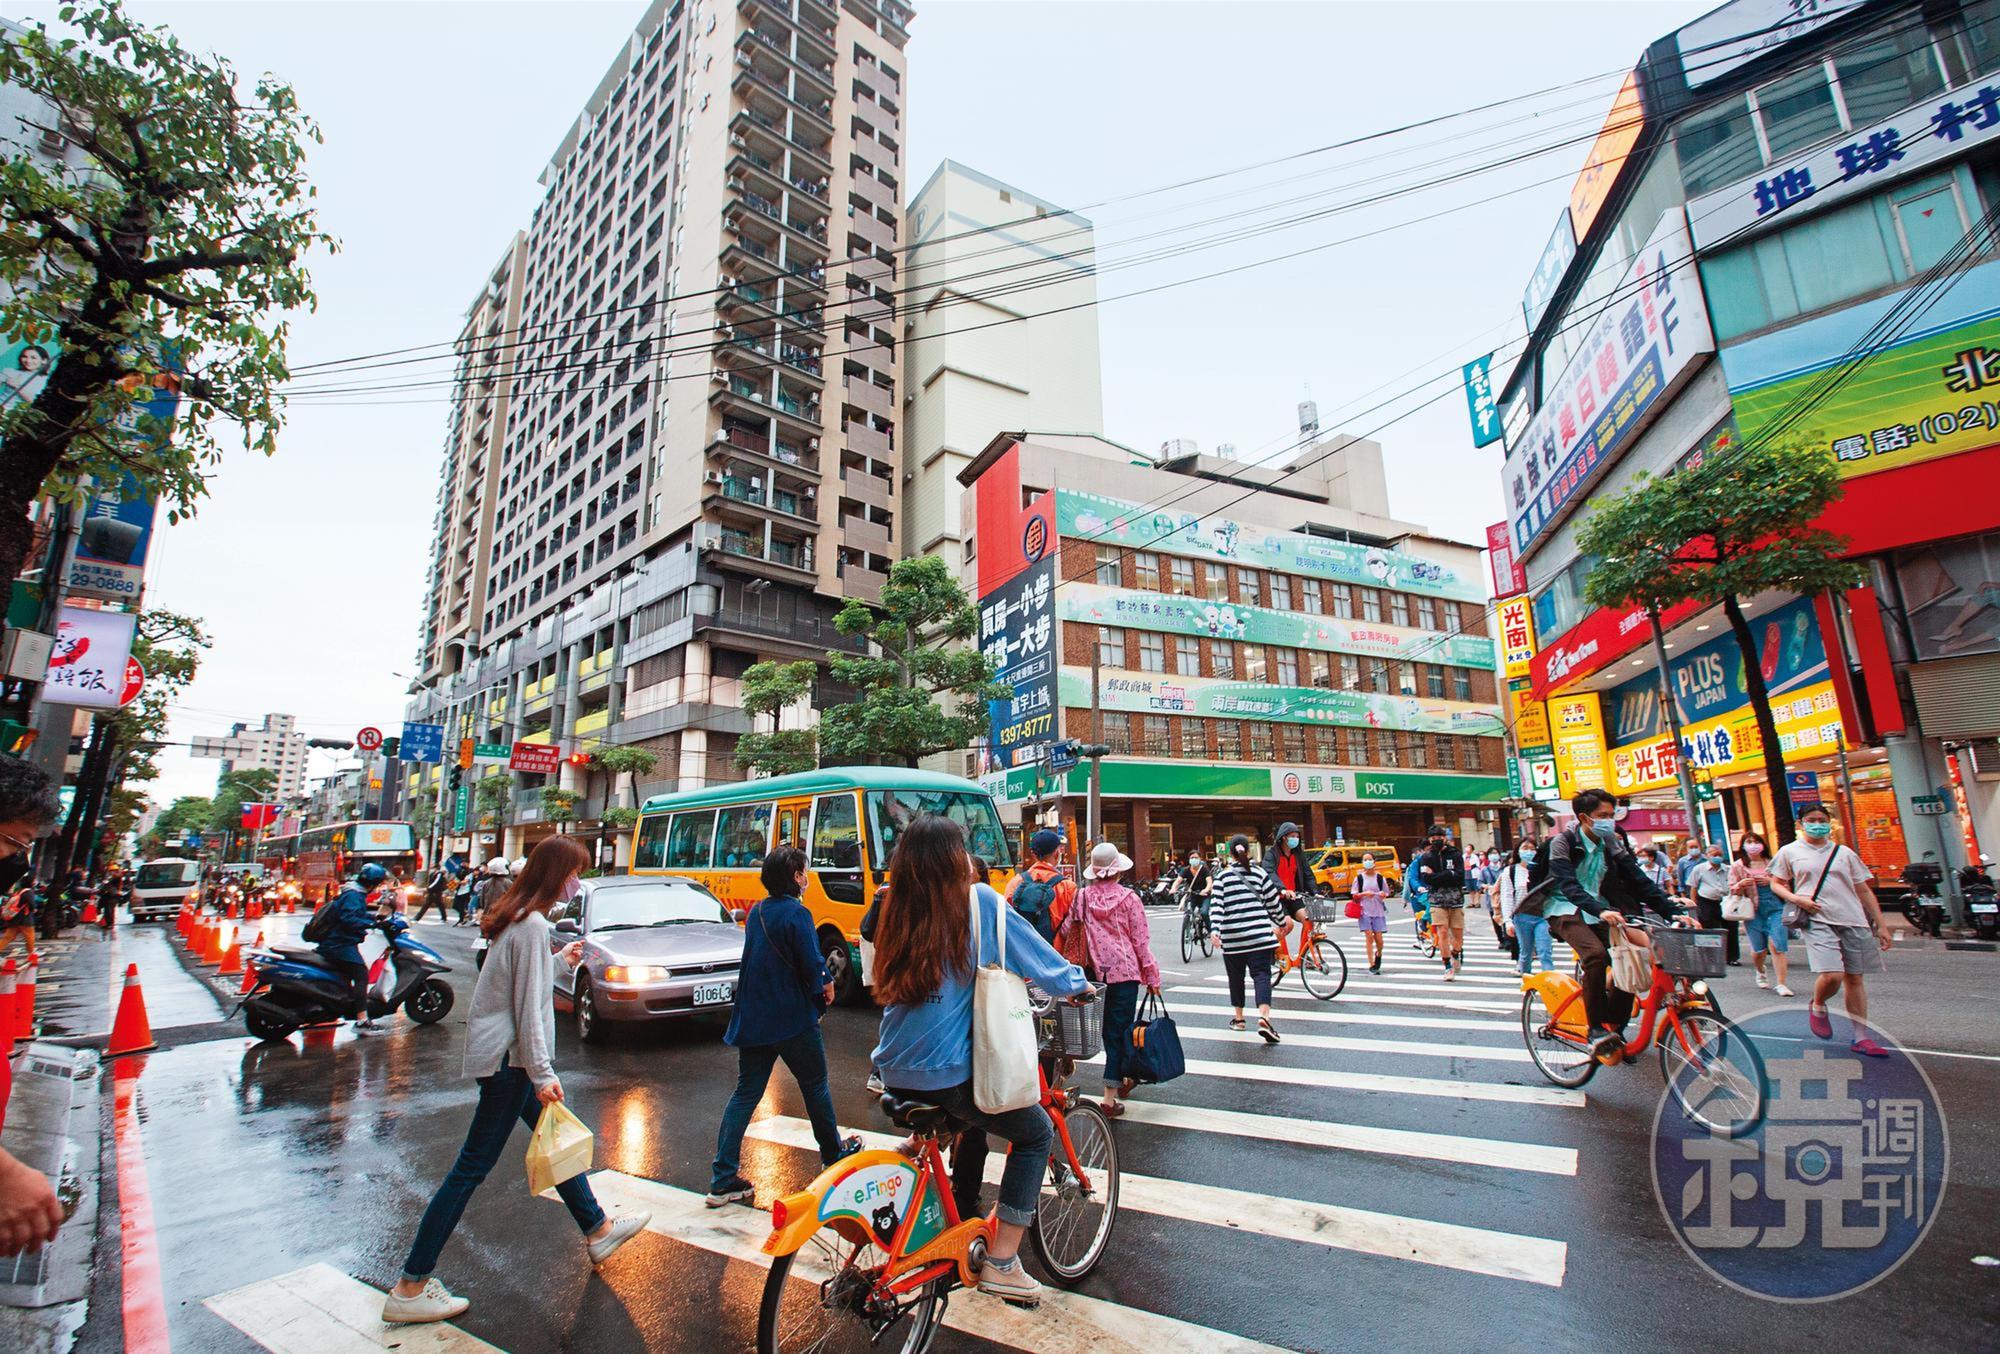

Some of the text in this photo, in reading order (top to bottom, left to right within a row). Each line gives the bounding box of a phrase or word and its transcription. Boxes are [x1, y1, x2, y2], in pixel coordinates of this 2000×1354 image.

[1754, 86, 2000, 216] 地球村
[1504, 603, 1529, 649] 光南
[1678, 651, 1725, 698] PLUS
[1694, 689, 1727, 710] JAPAN
[1008, 781, 1024, 794] POST
[1308, 775, 1345, 794] 郵局
[1365, 782, 1395, 795] POST
[854, 1175, 903, 1205] e.Fingo
